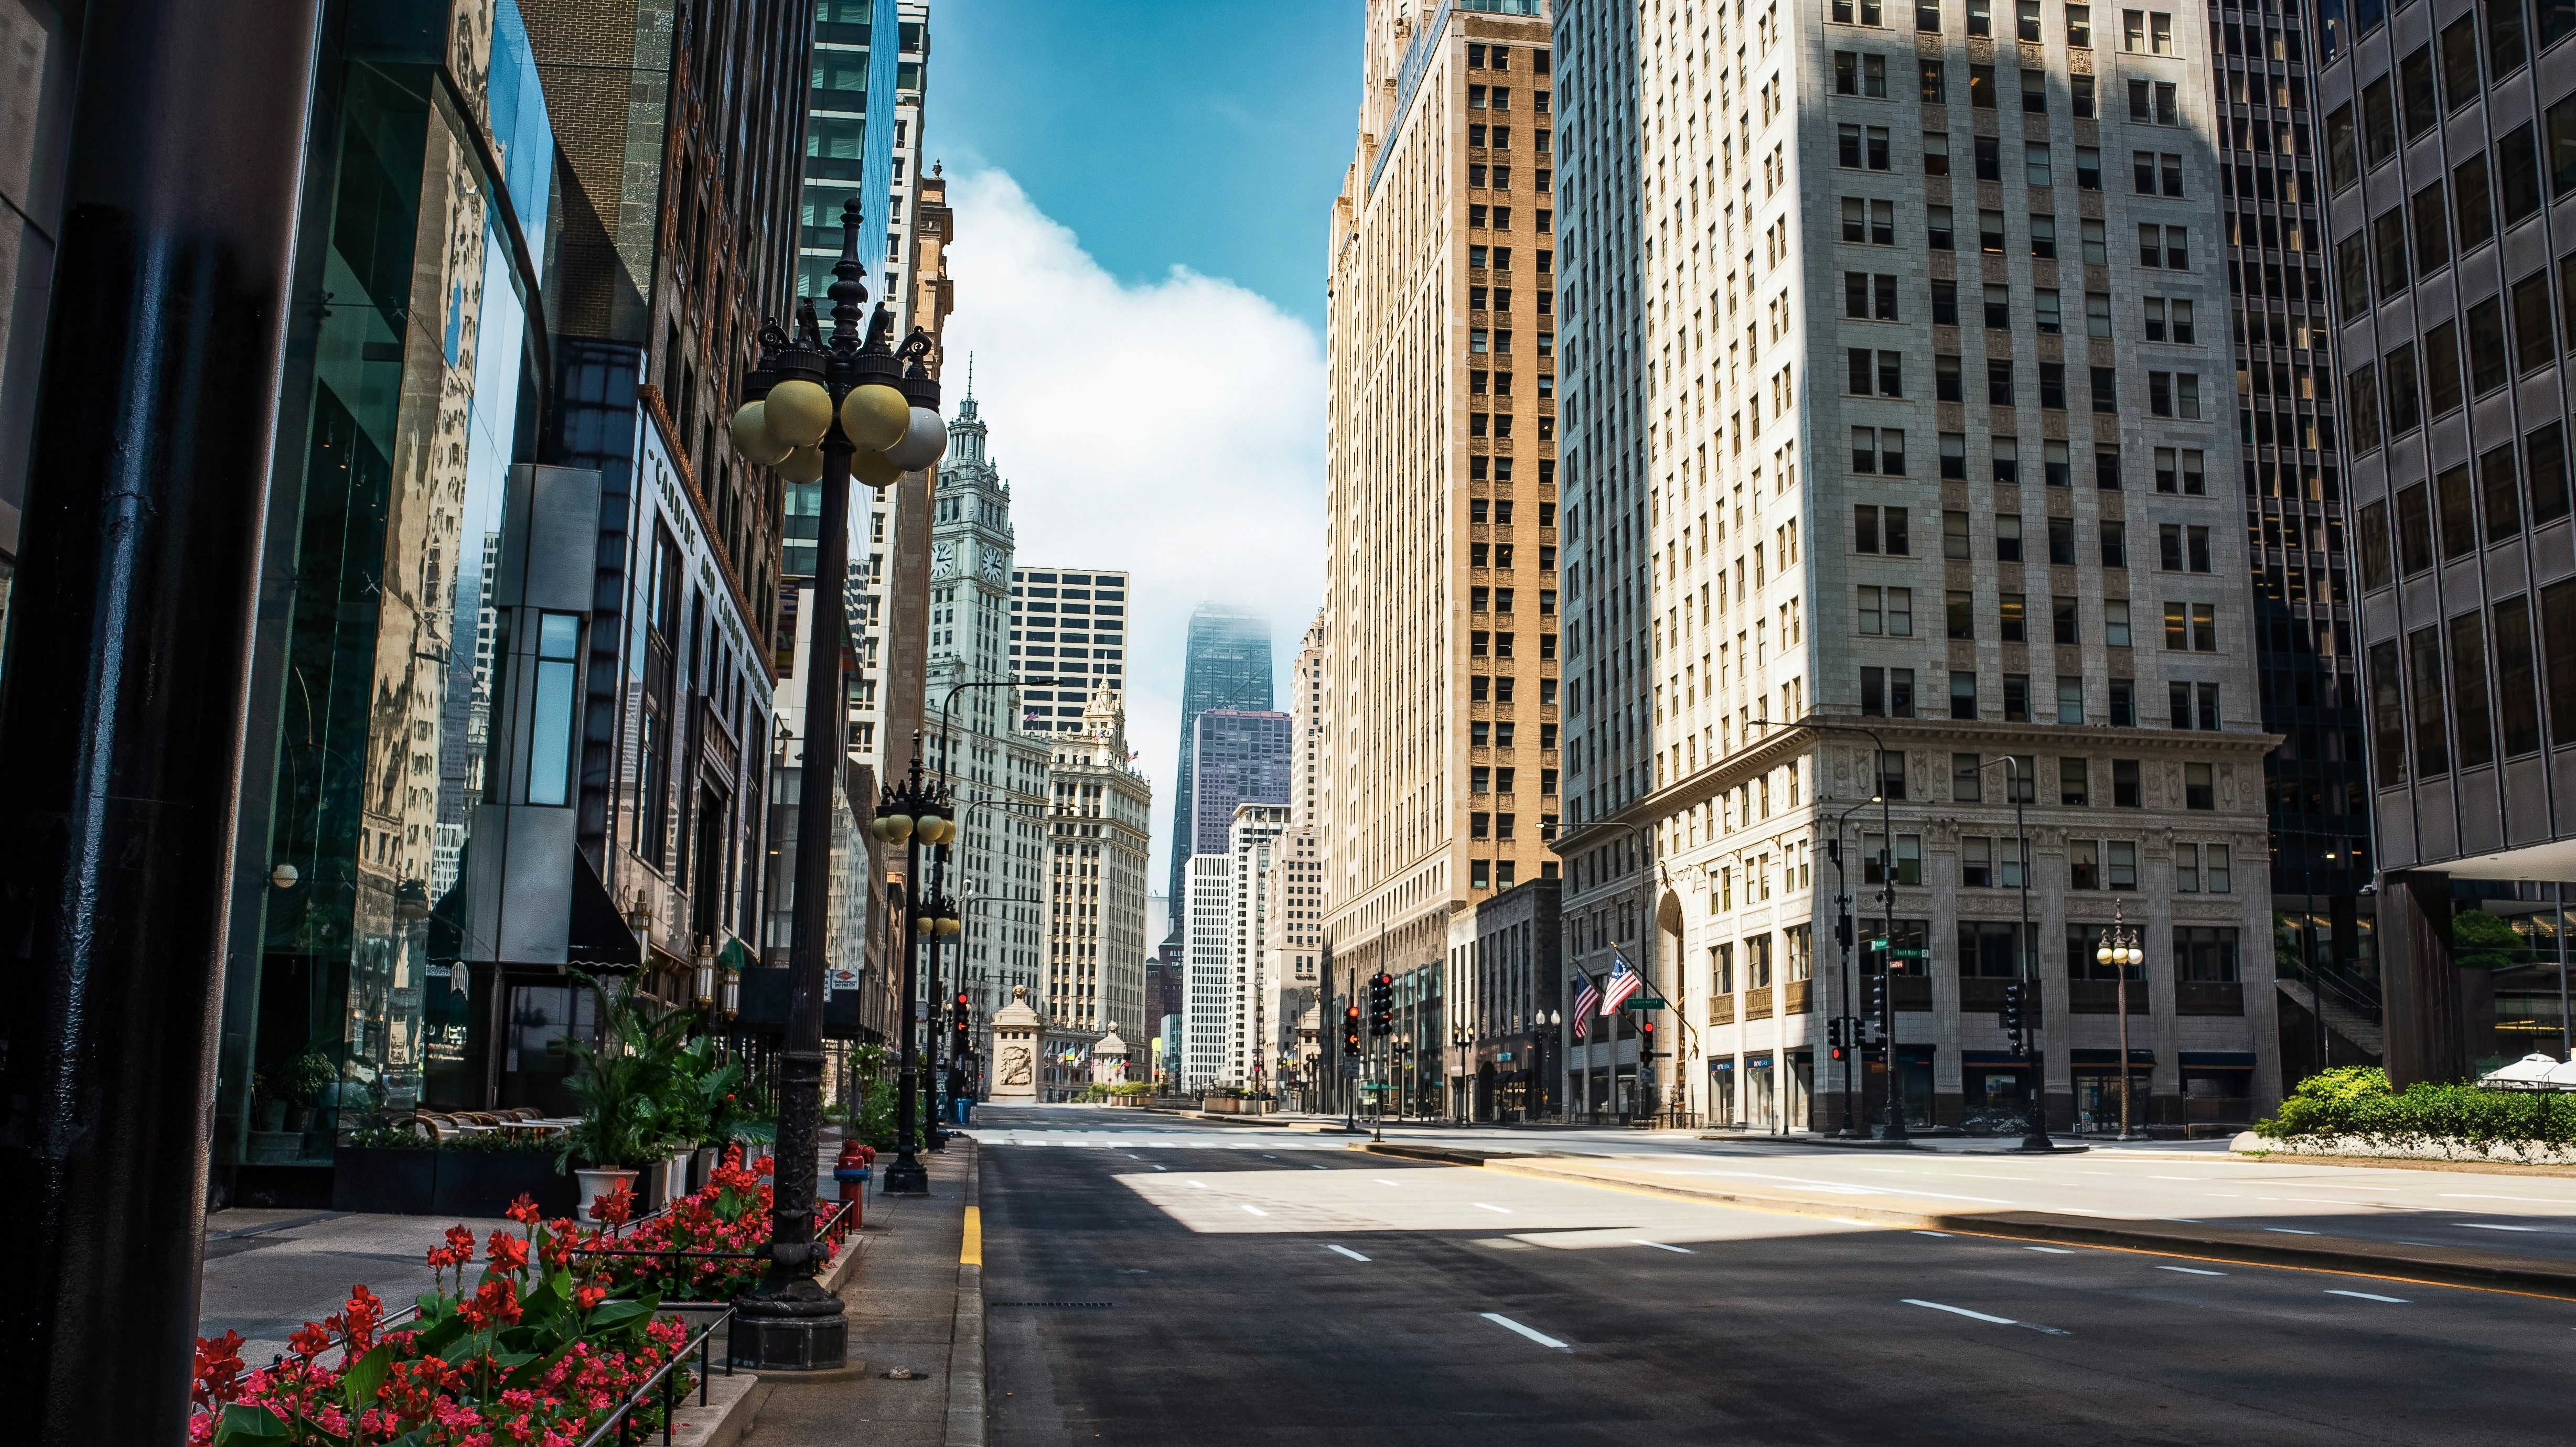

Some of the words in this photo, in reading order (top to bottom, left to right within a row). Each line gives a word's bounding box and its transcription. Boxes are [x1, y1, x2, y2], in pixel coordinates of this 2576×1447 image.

[656, 458, 695, 556] CARBIDE
[701, 554, 715, 597] AND
[719, 593, 743, 656] CARBON
